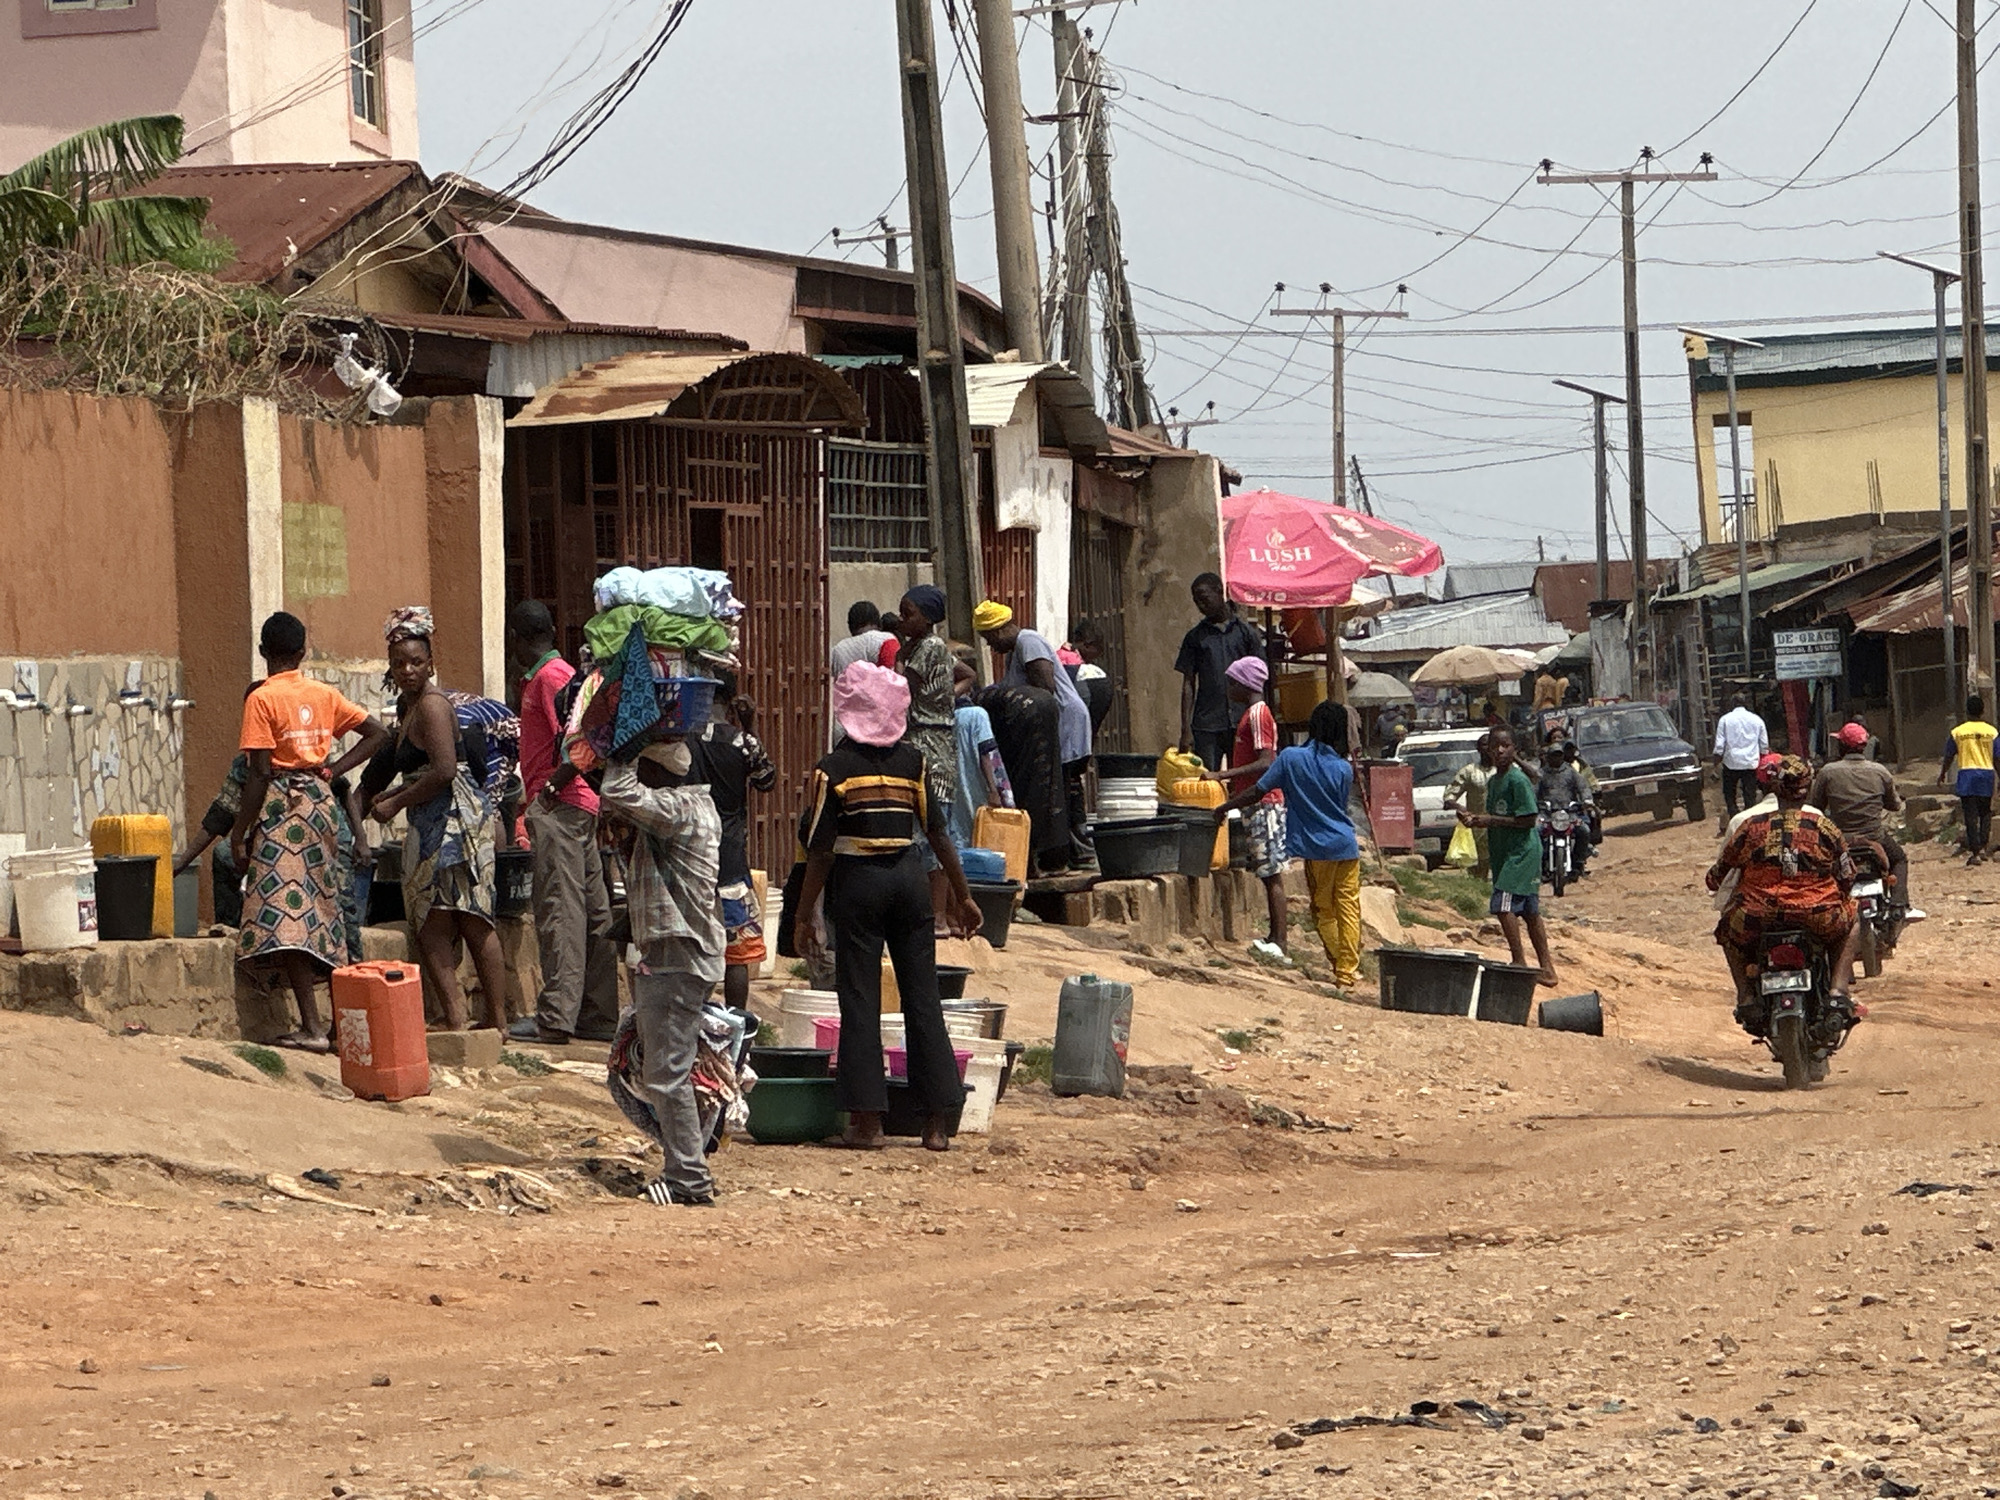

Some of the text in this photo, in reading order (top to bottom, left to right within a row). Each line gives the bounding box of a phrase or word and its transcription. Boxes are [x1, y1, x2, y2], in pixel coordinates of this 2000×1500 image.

[1249, 547, 1312, 562] LUSH
[1777, 631, 1839, 645] DE GRACE
